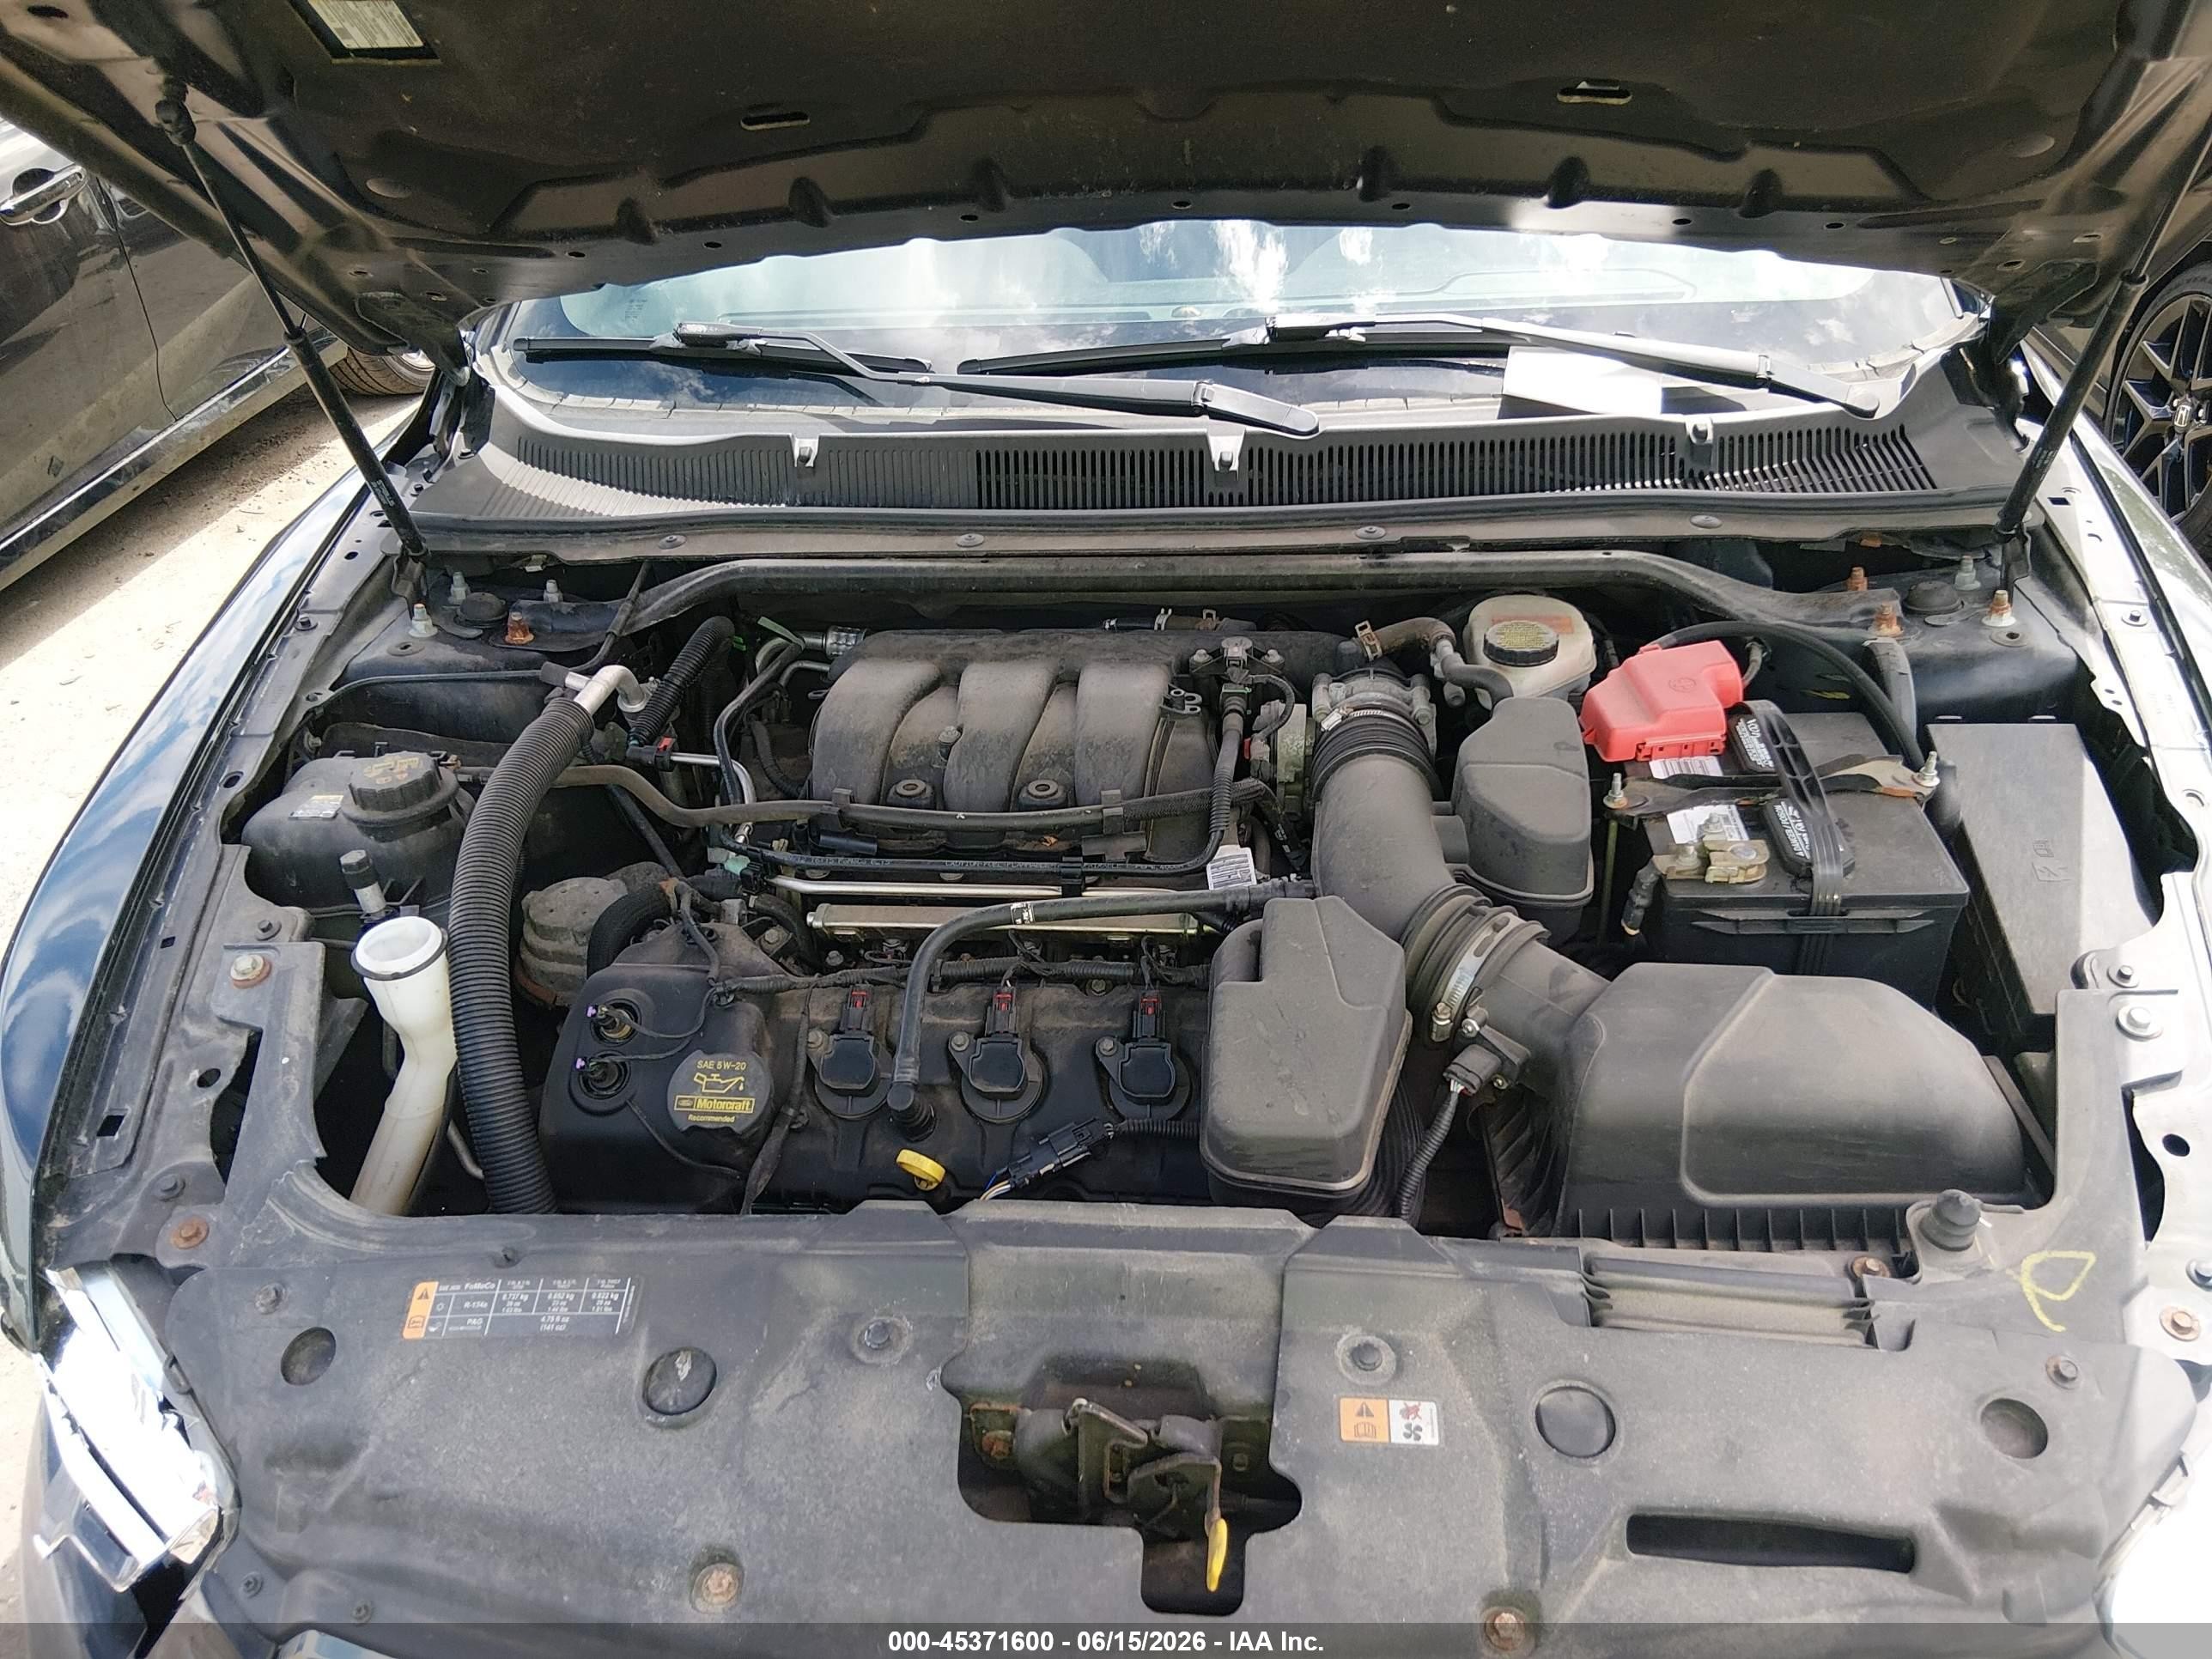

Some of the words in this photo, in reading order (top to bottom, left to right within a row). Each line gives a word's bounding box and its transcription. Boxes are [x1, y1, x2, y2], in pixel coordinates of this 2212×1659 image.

[696, 1060, 715, 1070] SAE
[716, 1060, 747, 1071] 5W-20
[696, 1098, 750, 1111] Motorcraft
[688, 1114, 736, 1122] Recommended
[464, 1282, 495, 1291] FoMoCo
[464, 1300, 488, 1309] R-134a
